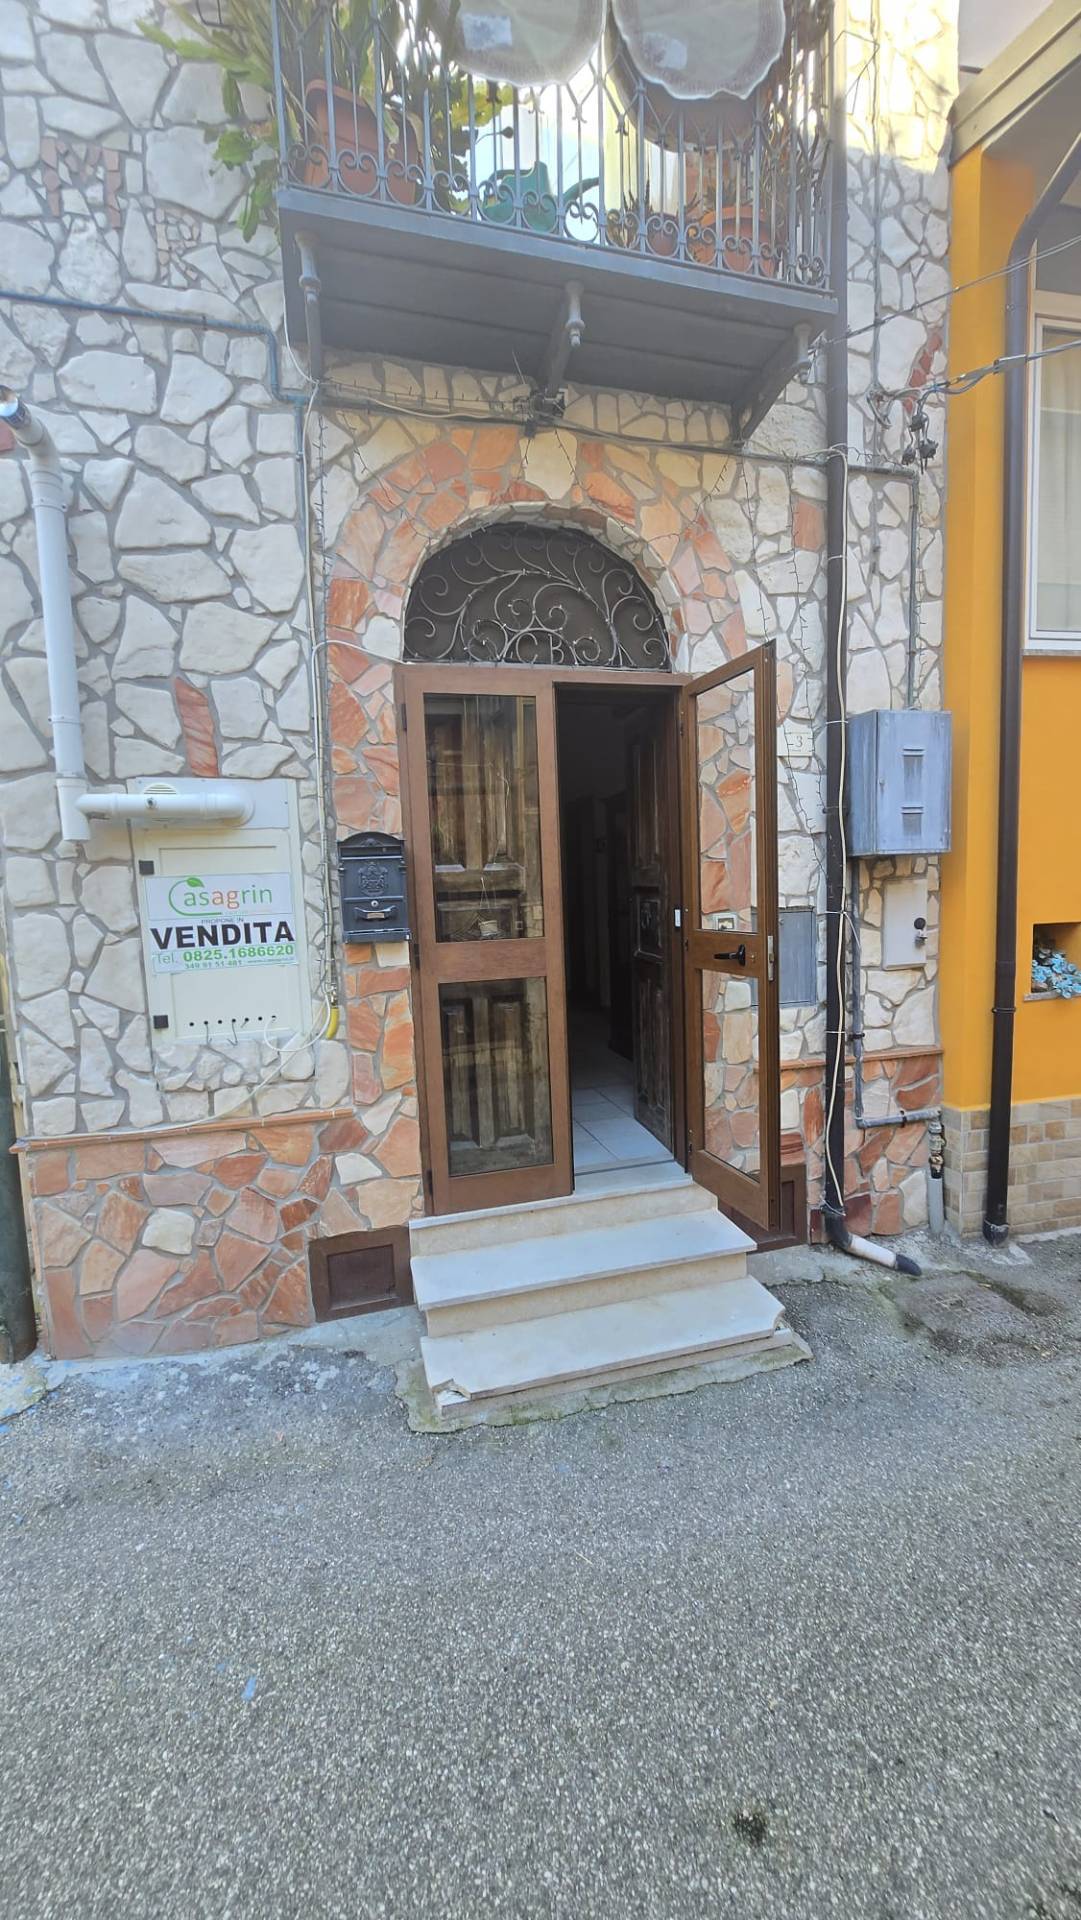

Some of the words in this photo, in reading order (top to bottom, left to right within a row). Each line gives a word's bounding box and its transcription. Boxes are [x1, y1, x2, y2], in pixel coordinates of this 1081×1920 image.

[168, 877, 272, 916] Casagrin
[150, 921, 295, 950] VENDITA
[157, 953, 178, 964] Tel.
[183, 944, 294, 962] 0825.1686620
